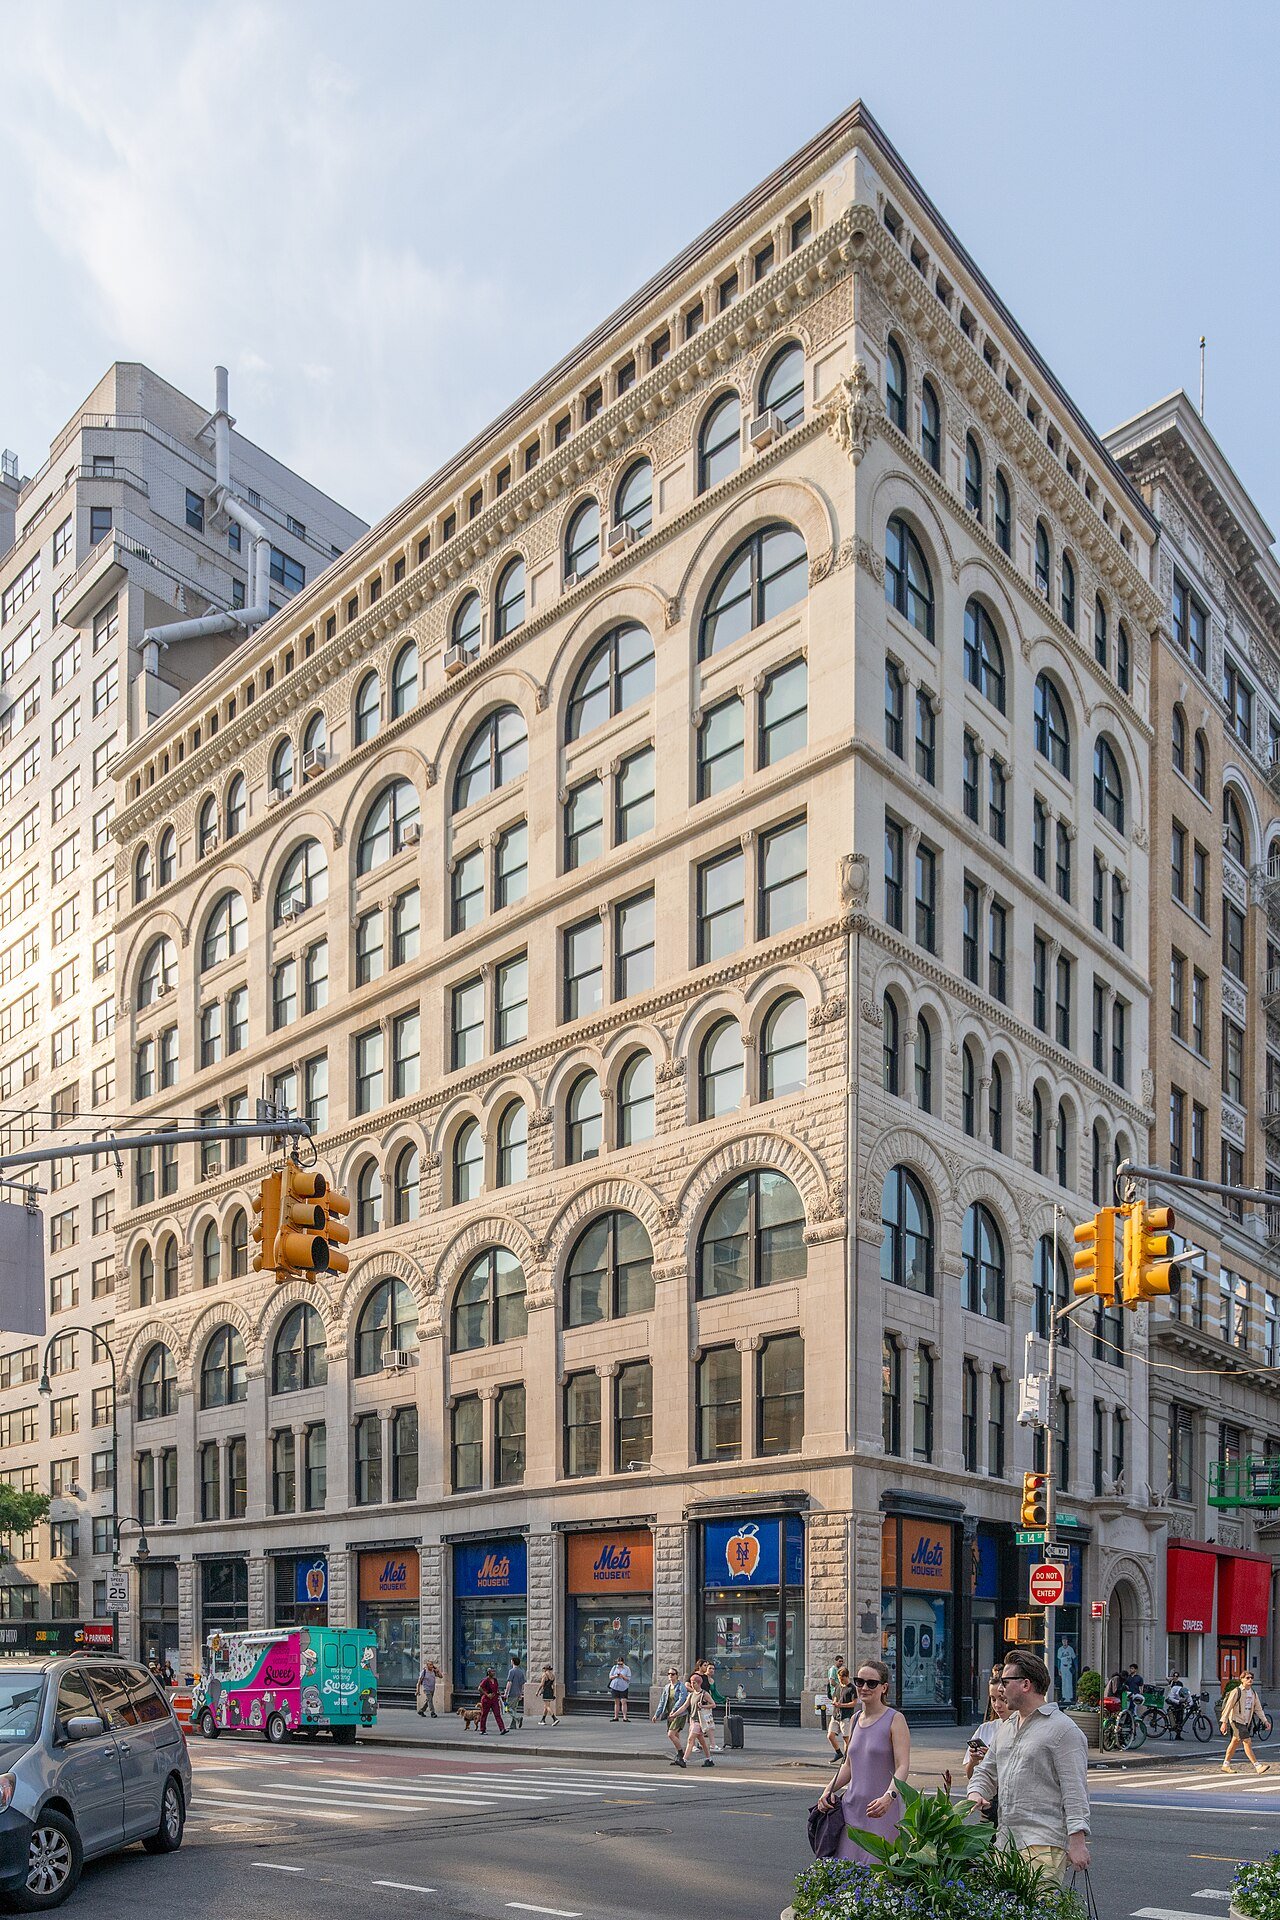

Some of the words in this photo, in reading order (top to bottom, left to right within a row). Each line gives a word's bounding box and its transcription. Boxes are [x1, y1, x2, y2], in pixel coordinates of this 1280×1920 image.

[1019, 1534, 1024, 1543] E
[1027, 1533, 1035, 1543] 14
[911, 1536, 944, 1566] Mets
[1058, 1548, 1067, 1556] WAY
[593, 1545, 631, 1570] Mets
[379, 1560, 407, 1583] Mets
[477, 1554, 510, 1578] Mets
[911, 1565, 935, 1576] HOUSE
[593, 1571, 621, 1580] HOUSE
[379, 1583, 400, 1591] HOUSE
[477, 1578, 501, 1588] HOUSE
[109, 1587, 126, 1599] 25
[1182, 1619, 1203, 1631] STAPLES
[1240, 1623, 1258, 1634] STAPLES
[89, 1634, 111, 1643] PARKING
[264, 1665, 295, 1686] Sweet
[330, 1667, 352, 1675] making
[322, 1679, 359, 1696] Sweet
